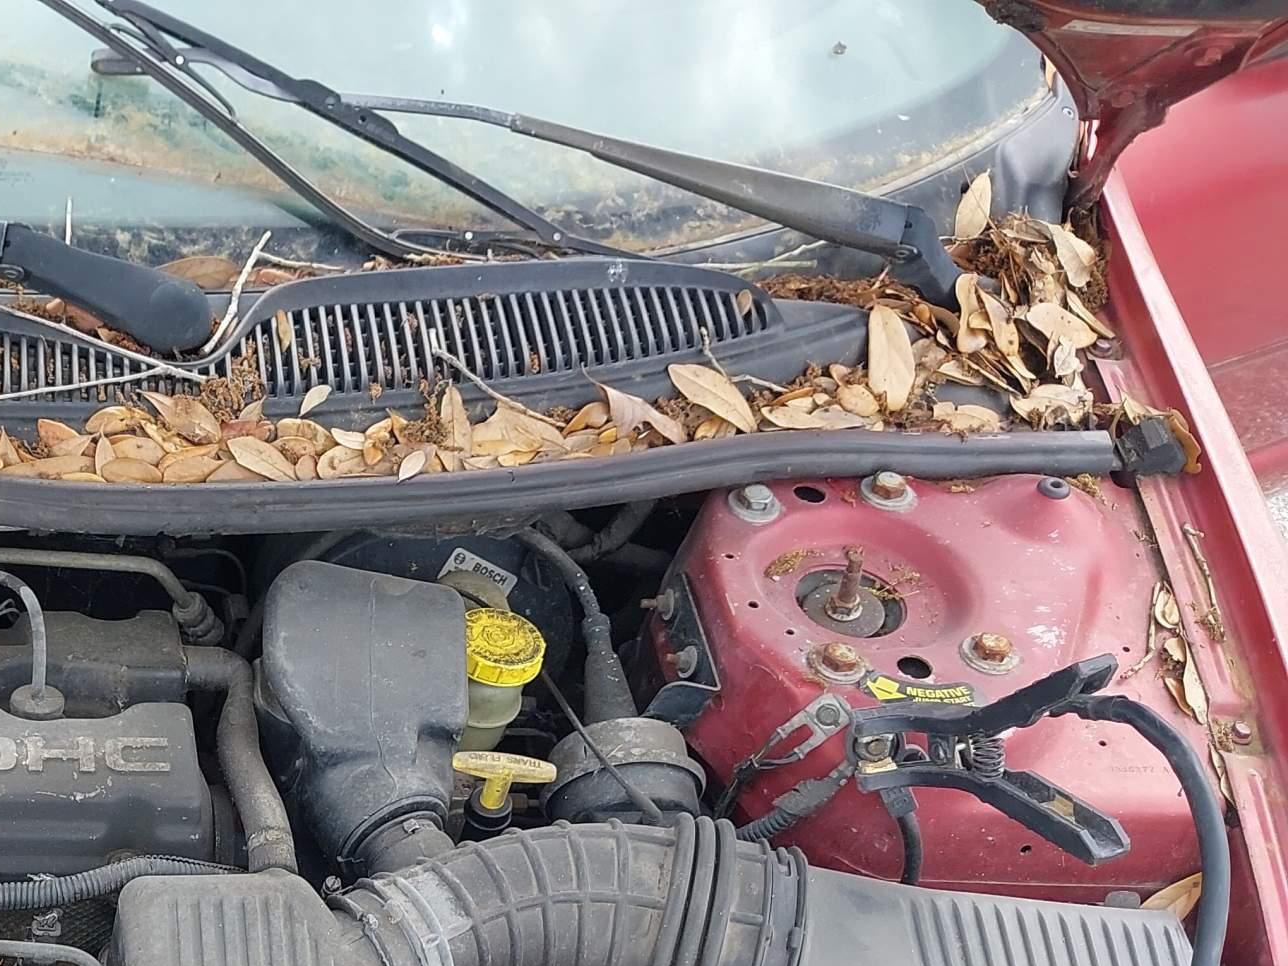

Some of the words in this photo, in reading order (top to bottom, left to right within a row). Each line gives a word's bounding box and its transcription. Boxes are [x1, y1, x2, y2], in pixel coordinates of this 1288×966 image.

[472, 562, 509, 586] BOSCH
[905, 685, 971, 699] NEGATIVE
[506, 756, 542, 769] TRANS
